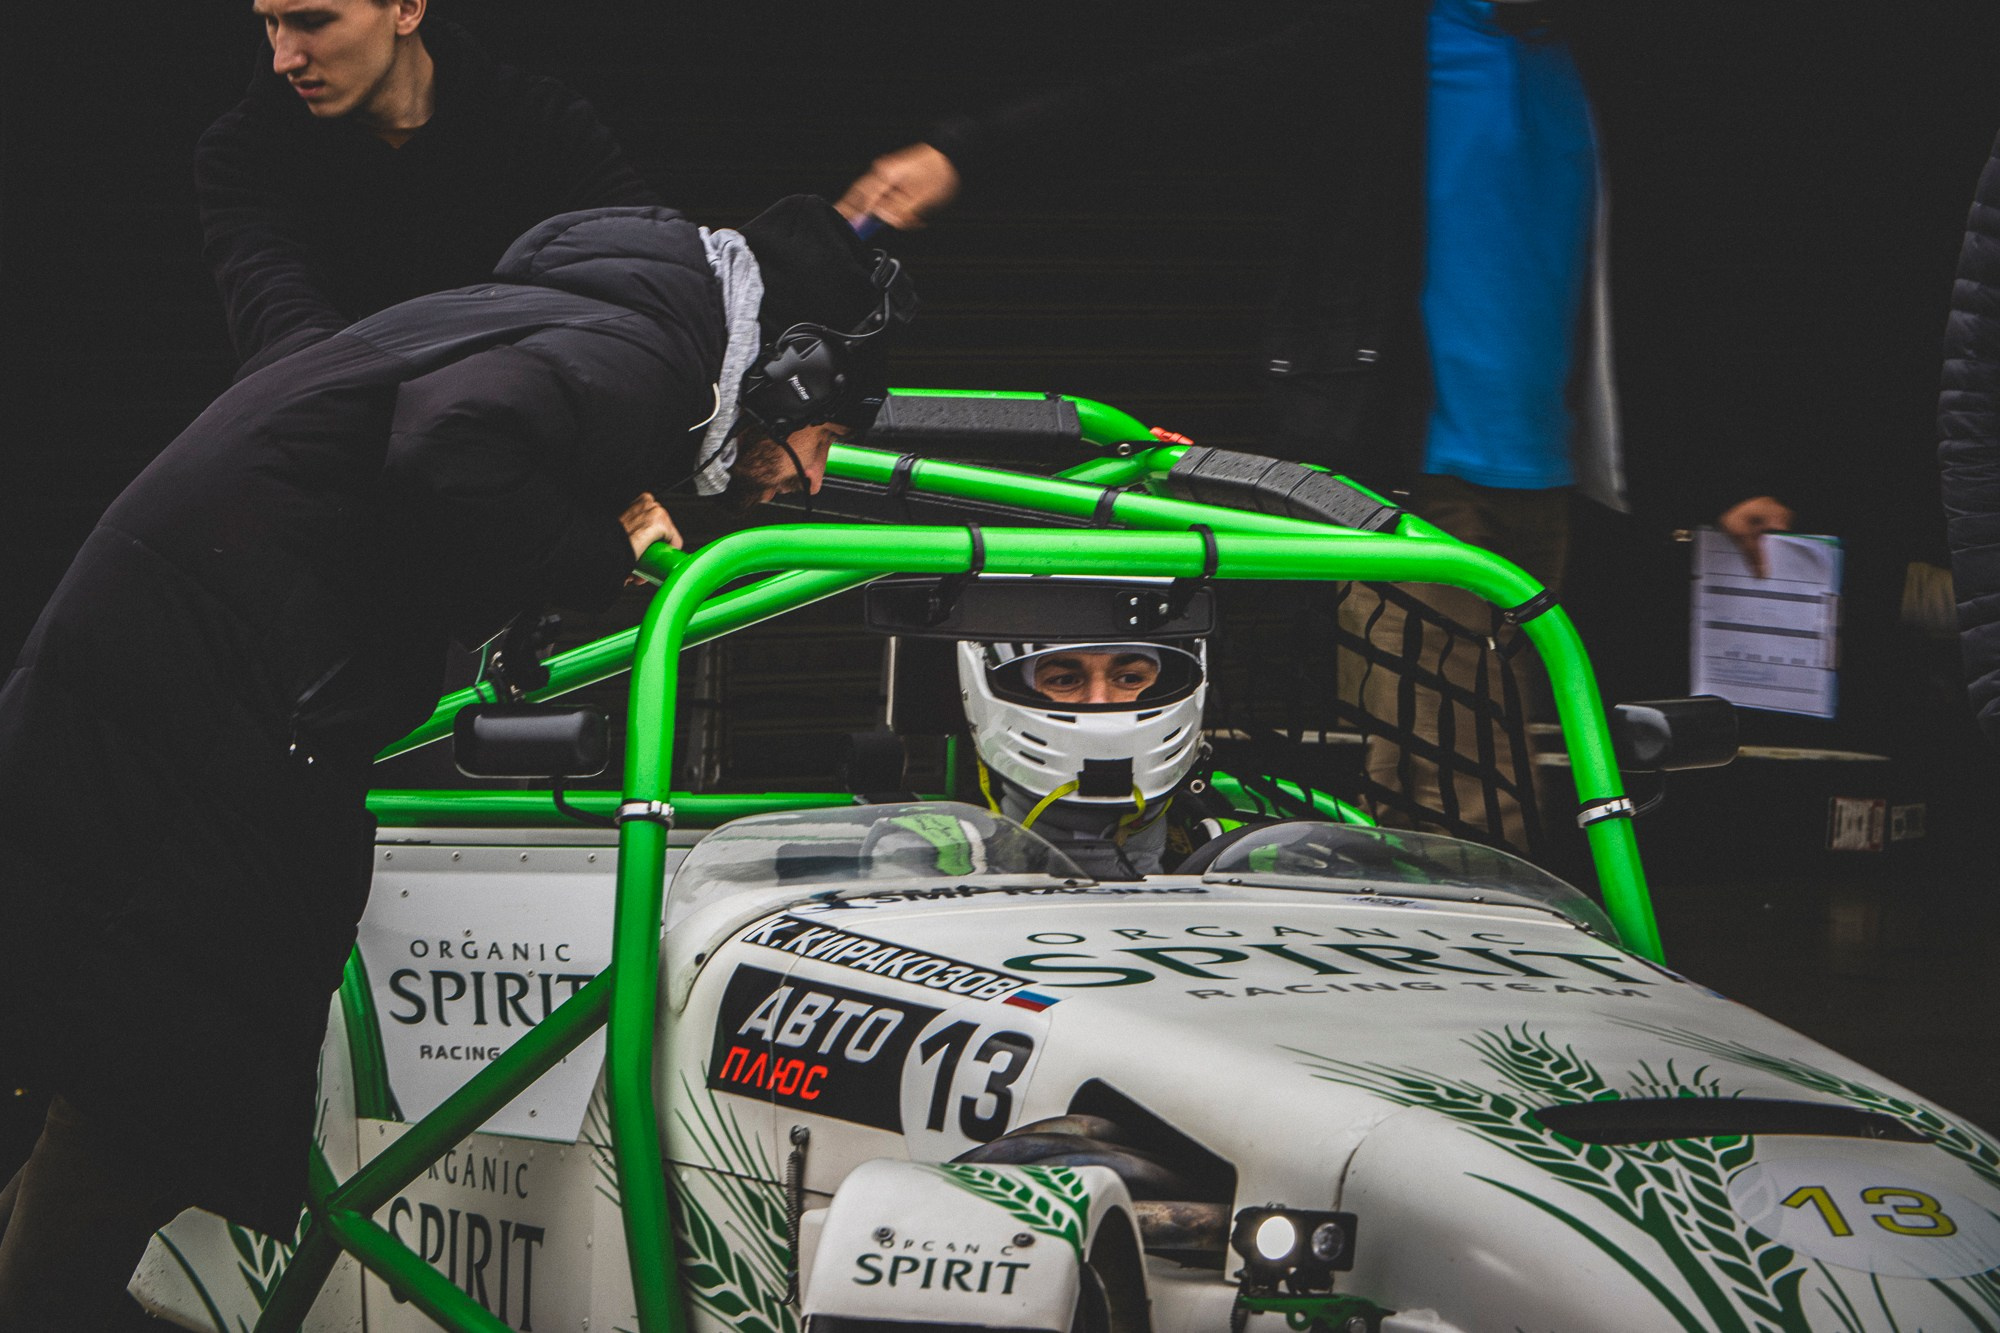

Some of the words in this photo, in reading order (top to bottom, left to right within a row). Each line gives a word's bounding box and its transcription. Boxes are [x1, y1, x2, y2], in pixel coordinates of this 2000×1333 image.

[410, 939, 571, 962] ORGANIC
[1026, 925, 1525, 945] ORGANIC
[1002, 943, 1660, 988] SPIRIT
[388, 968, 597, 1027] SPIRIT
[1185, 982, 1448, 999] RACING
[1460, 981, 1653, 999] TEAM
[737, 985, 905, 1063] АВТО
[419, 1044, 501, 1061] RACING
[719, 1046, 829, 1101] ПЛЮС
[920, 1019, 1036, 1144] 13
[1780, 1185, 1958, 1237] 13
[852, 1253, 1032, 1295] SPIRIT
